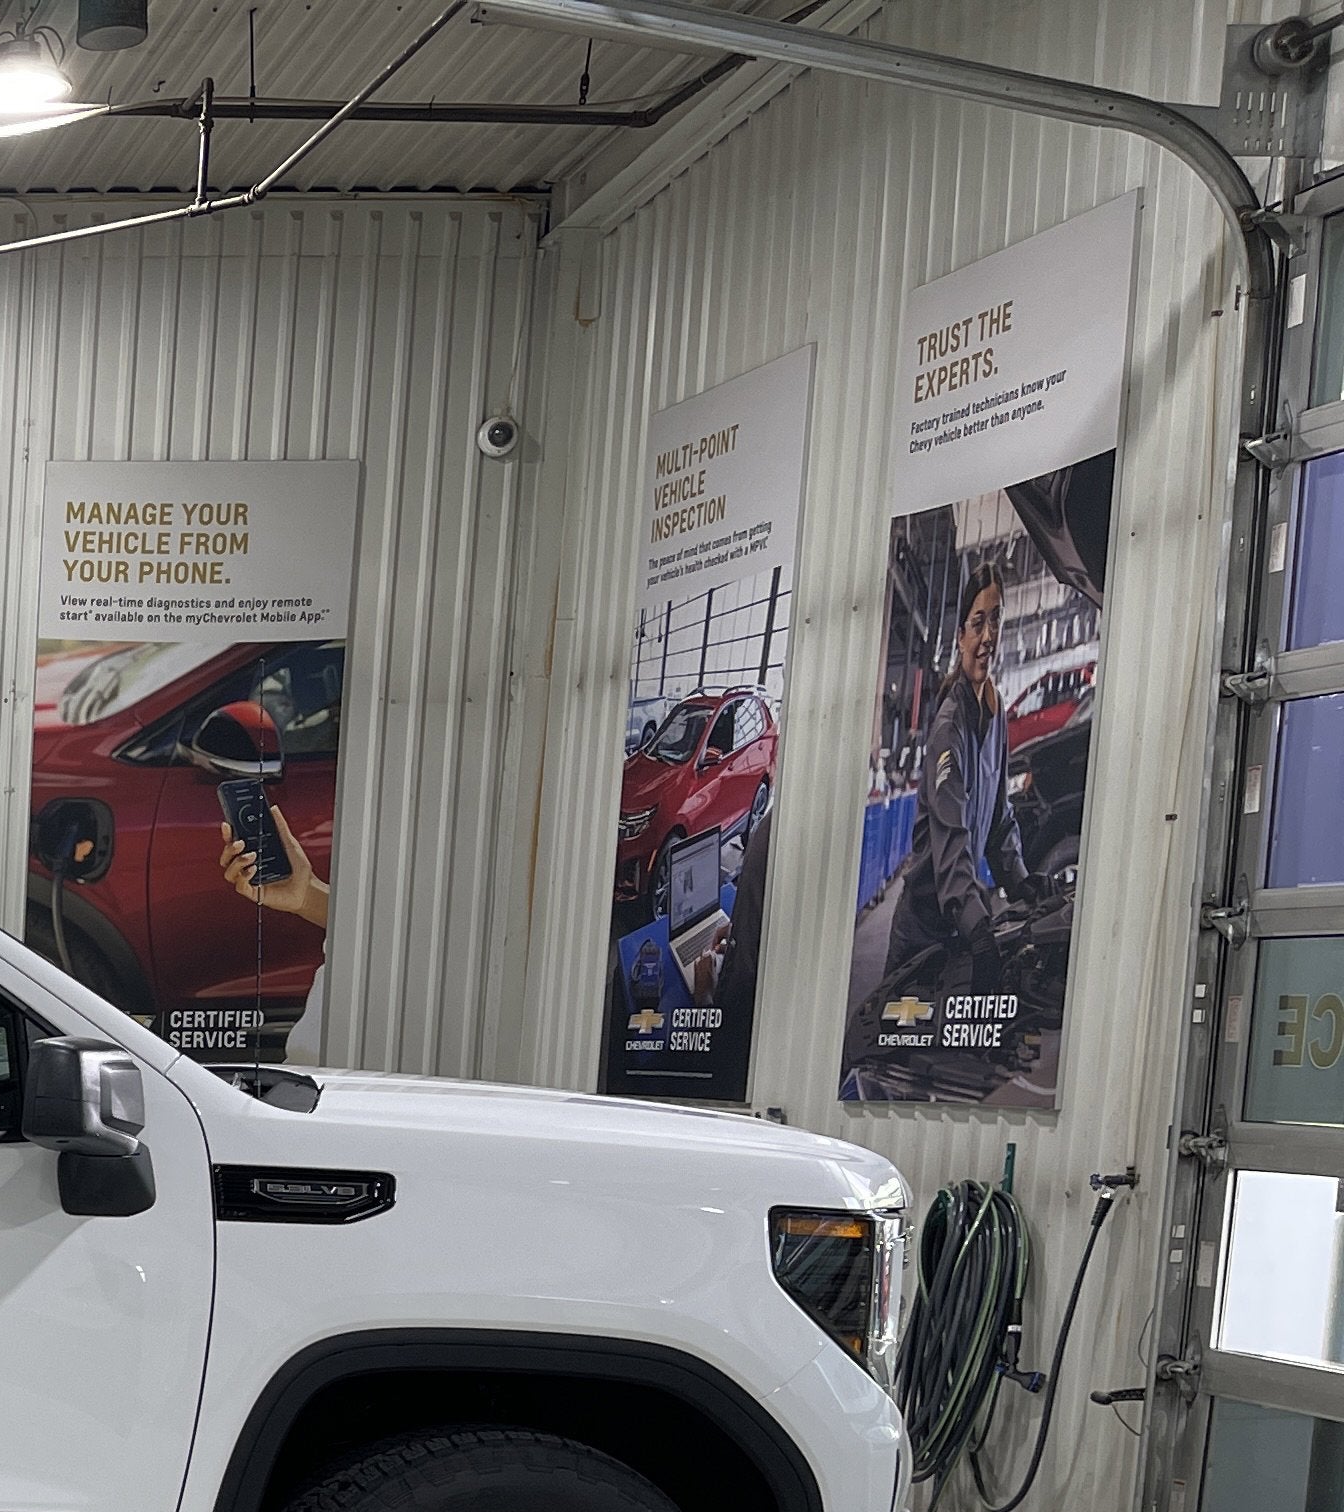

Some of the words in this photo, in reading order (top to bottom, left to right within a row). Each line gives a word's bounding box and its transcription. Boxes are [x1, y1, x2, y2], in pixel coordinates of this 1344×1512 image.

[917, 317, 973, 365] TRUST
[978, 300, 1013, 341] THE
[914, 348, 998, 404] EXPERTS.
[911, 416, 940, 435] Factory
[942, 403, 971, 424] trained
[972, 387, 1019, 413] technicians
[1021, 378, 1045, 397] know
[1045, 370, 1067, 392] your
[910, 437, 933, 453] Chevy
[934, 426, 961, 446] vehicle
[963, 418, 989, 437] better
[990, 411, 1009, 427] than
[656, 424, 740, 479] MULTI-POINT
[654, 470, 706, 511] VEHICLE
[66, 502, 174, 525] MANAGE
[182, 503, 249, 526] YOUR
[651, 495, 726, 543] INSPECTION
[64, 531, 170, 554] VEHICLE
[180, 532, 249, 554] FROM
[63, 559, 129, 583] YOUR
[138, 562, 231, 584] PHONE.
[61, 595, 87, 606] View
[91, 596, 143, 607] real-time
[147, 597, 211, 610] diagnostics
[215, 598, 234, 608] and
[238, 597, 268, 610] enjoy
[272, 597, 312, 607] remote
[94, 611, 143, 622] available
[147, 614, 160, 622] on
[164, 612, 182, 623] the
[186, 612, 257, 625] myChevrolet
[260, 612, 296, 622] Mobile
[672, 1008, 722, 1027] CERTIFIED
[945, 995, 1018, 1018] CERTIFIED
[170, 1010, 264, 1028] CERTIFIED
[169, 1031, 247, 1048] SERVICE
[670, 1032, 711, 1051] SERVICE
[878, 1034, 934, 1046] CHEVROLET
[942, 1024, 1002, 1047] SERVICE
